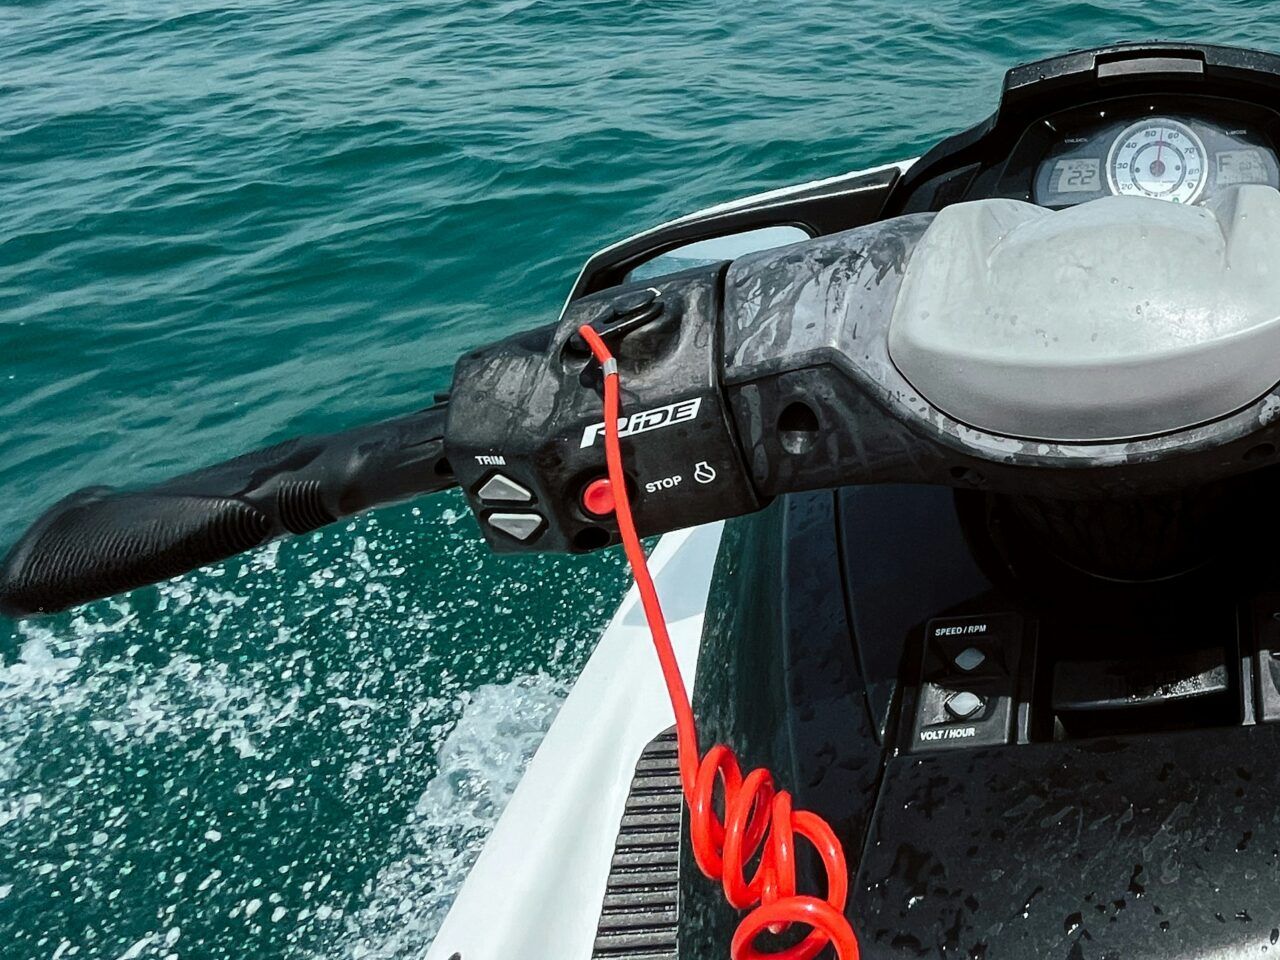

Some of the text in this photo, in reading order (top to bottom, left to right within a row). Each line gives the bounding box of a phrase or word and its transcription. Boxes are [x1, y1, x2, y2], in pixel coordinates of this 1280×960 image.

[1144, 130, 1157, 138] 50
[1167, 132, 1180, 140] 60
[1188, 168, 1200, 176] 80
[1067, 170, 1096, 186] 22
[1121, 183, 1134, 191] 20
[474, 455, 506, 465] TRIM
[645, 474, 682, 493] STOP
